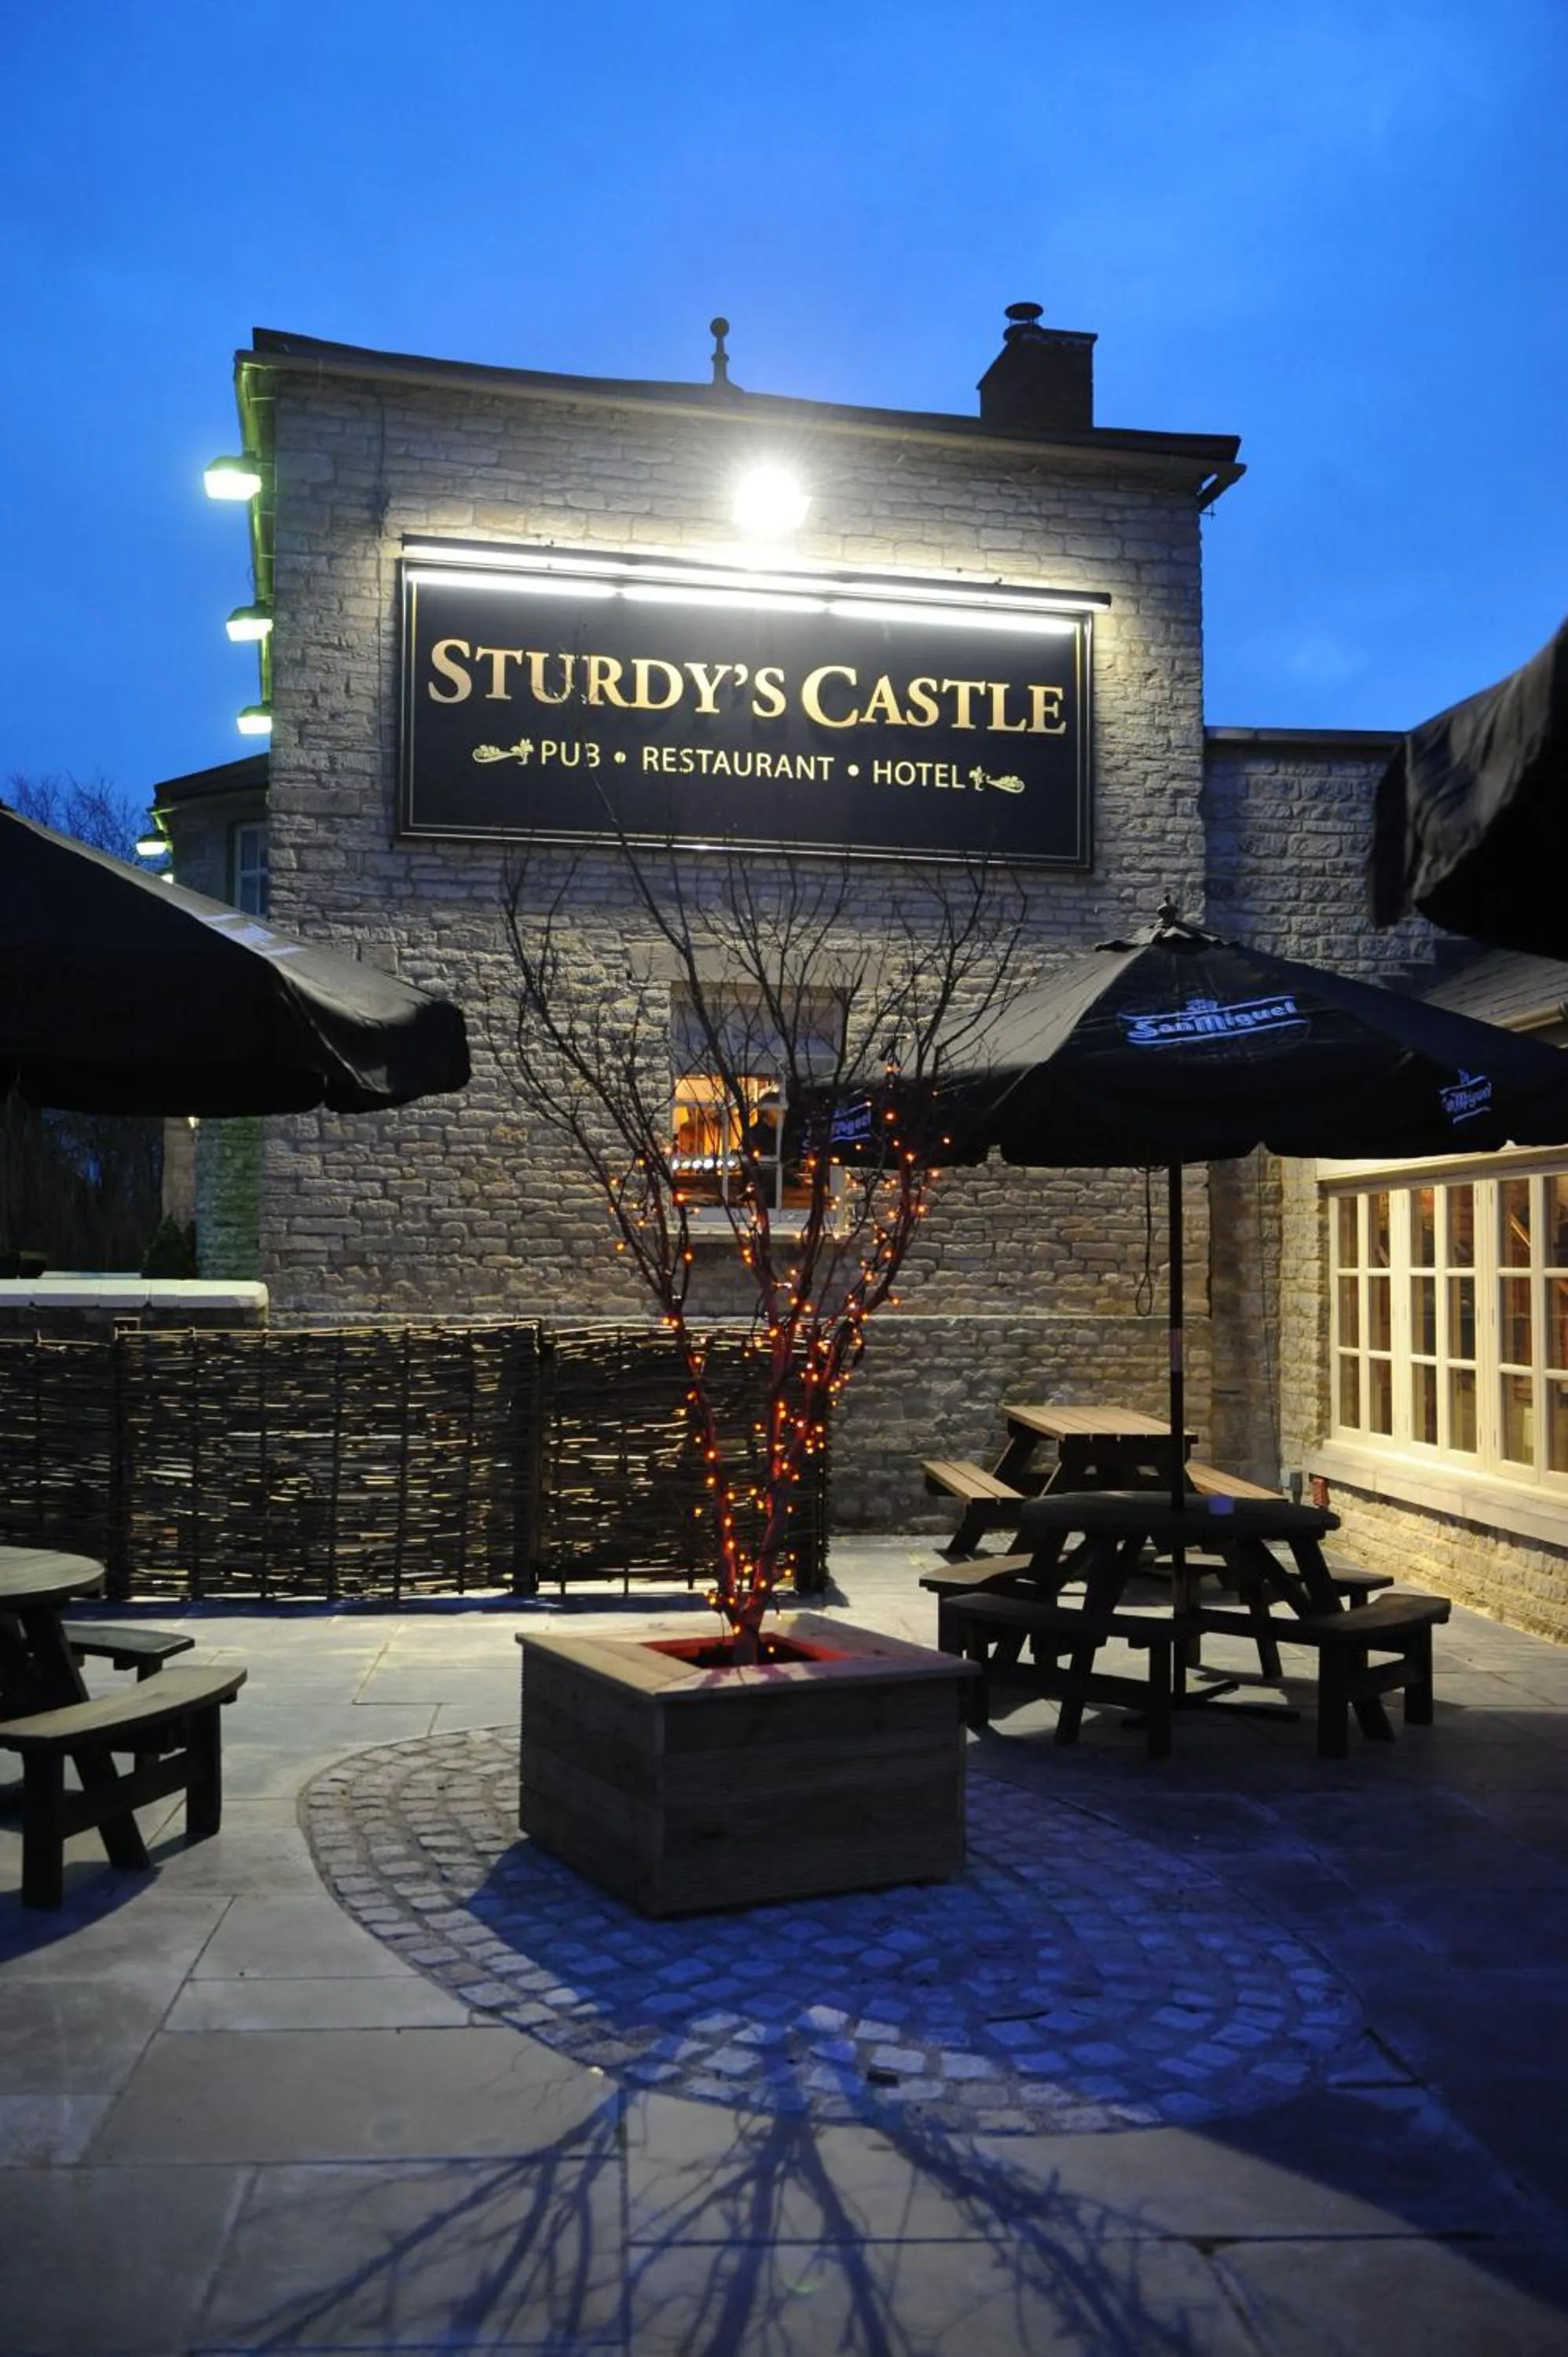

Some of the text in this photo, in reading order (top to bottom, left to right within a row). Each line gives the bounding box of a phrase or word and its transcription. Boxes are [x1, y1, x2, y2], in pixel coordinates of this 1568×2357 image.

[427, 638, 1067, 735] STURDY'S CASTLE
[540, 740, 966, 790] PUB RESTAURANT HOTEL
